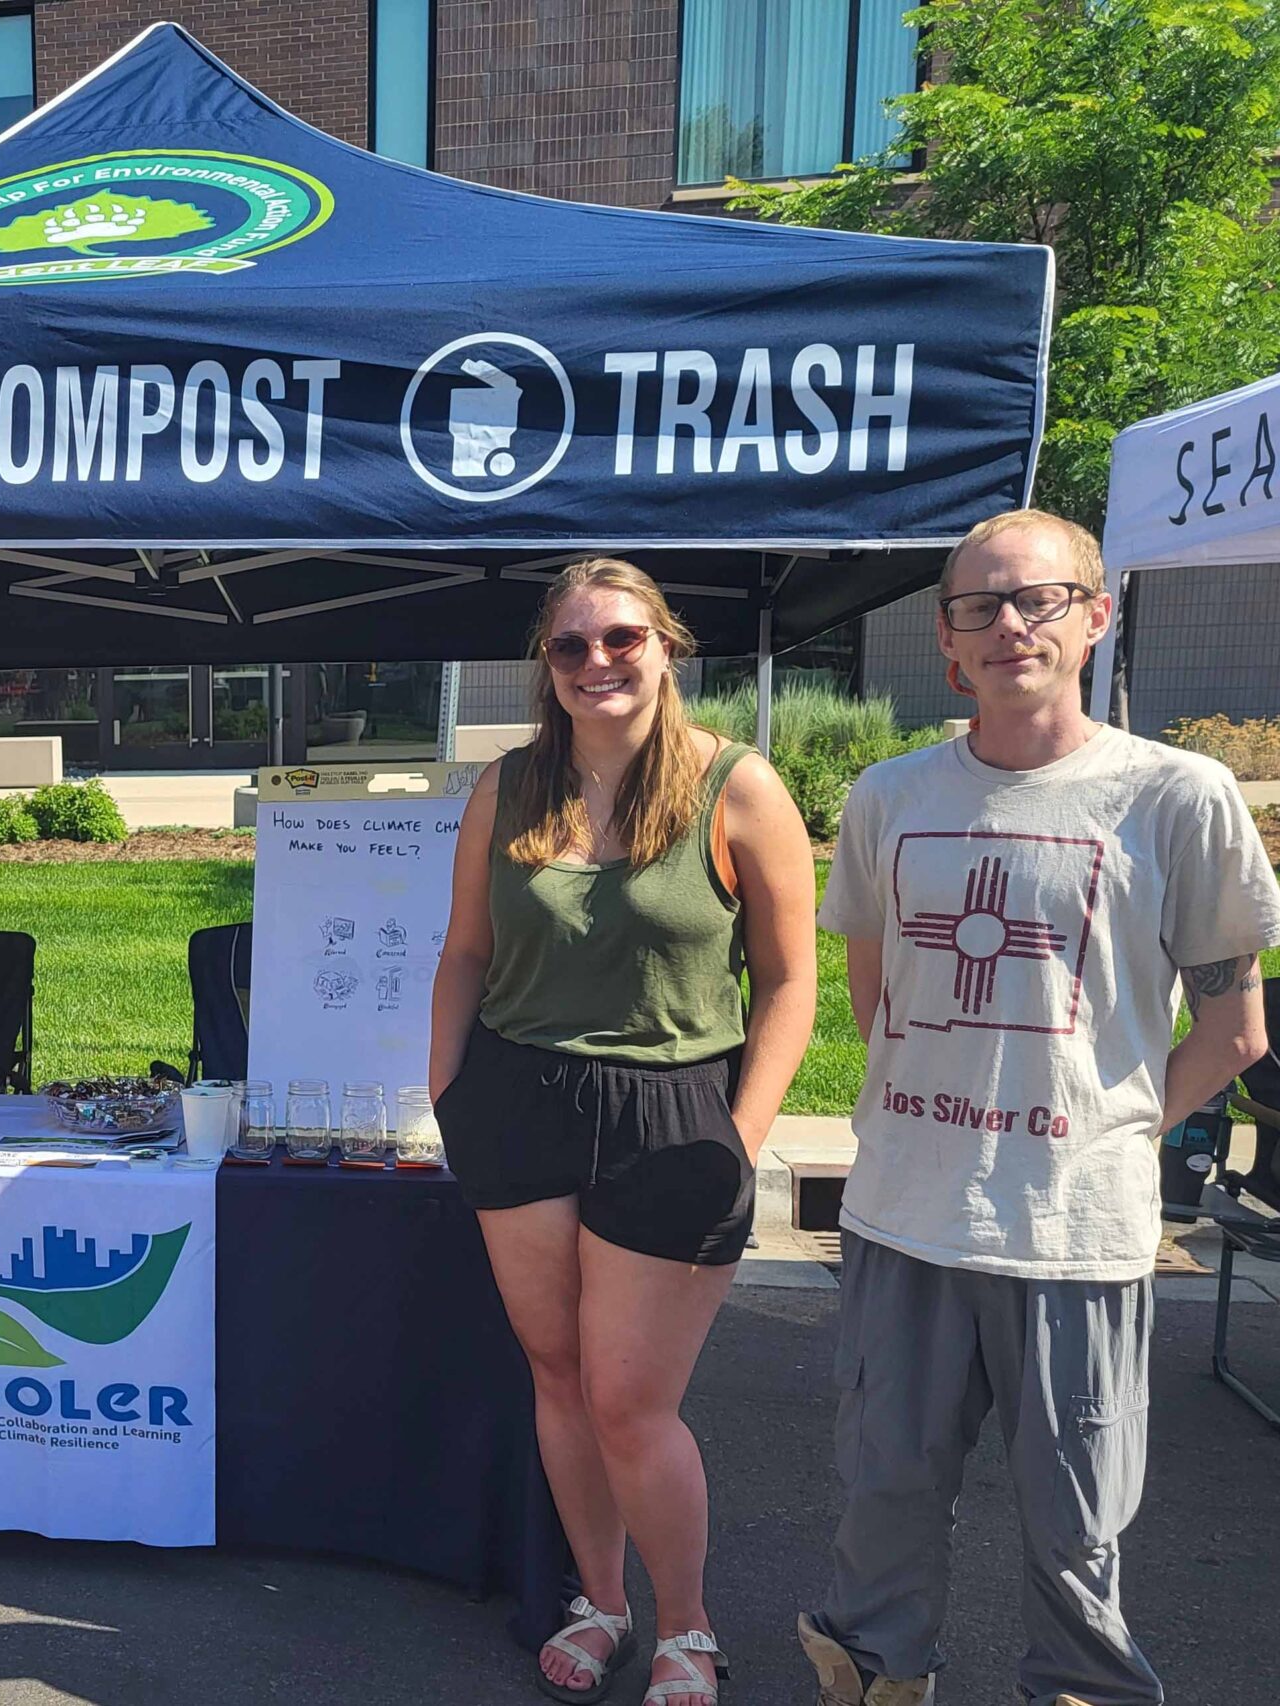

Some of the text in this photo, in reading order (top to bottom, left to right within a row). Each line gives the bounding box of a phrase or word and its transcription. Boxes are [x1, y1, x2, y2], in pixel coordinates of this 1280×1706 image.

[33, 173, 85, 193] For
[94, 163, 286, 200] Environmental
[254, 199, 293, 231] Action
[111, 259, 217, 270] LEAF
[604, 342, 916, 475] TRASH
[290, 774, 316, 782] Post-it
[316, 818, 351, 831] DOES
[363, 819, 422, 833] CLIMATE
[289, 839, 421, 860] MAKE YOU FEEL?
[932, 1092, 1020, 1132] Silver
[1028, 1105, 1070, 1139] Co
[50, 1436, 120, 1450] Resilience
[92, 1425, 118, 1437] and
[122, 1425, 182, 1443] Learning
